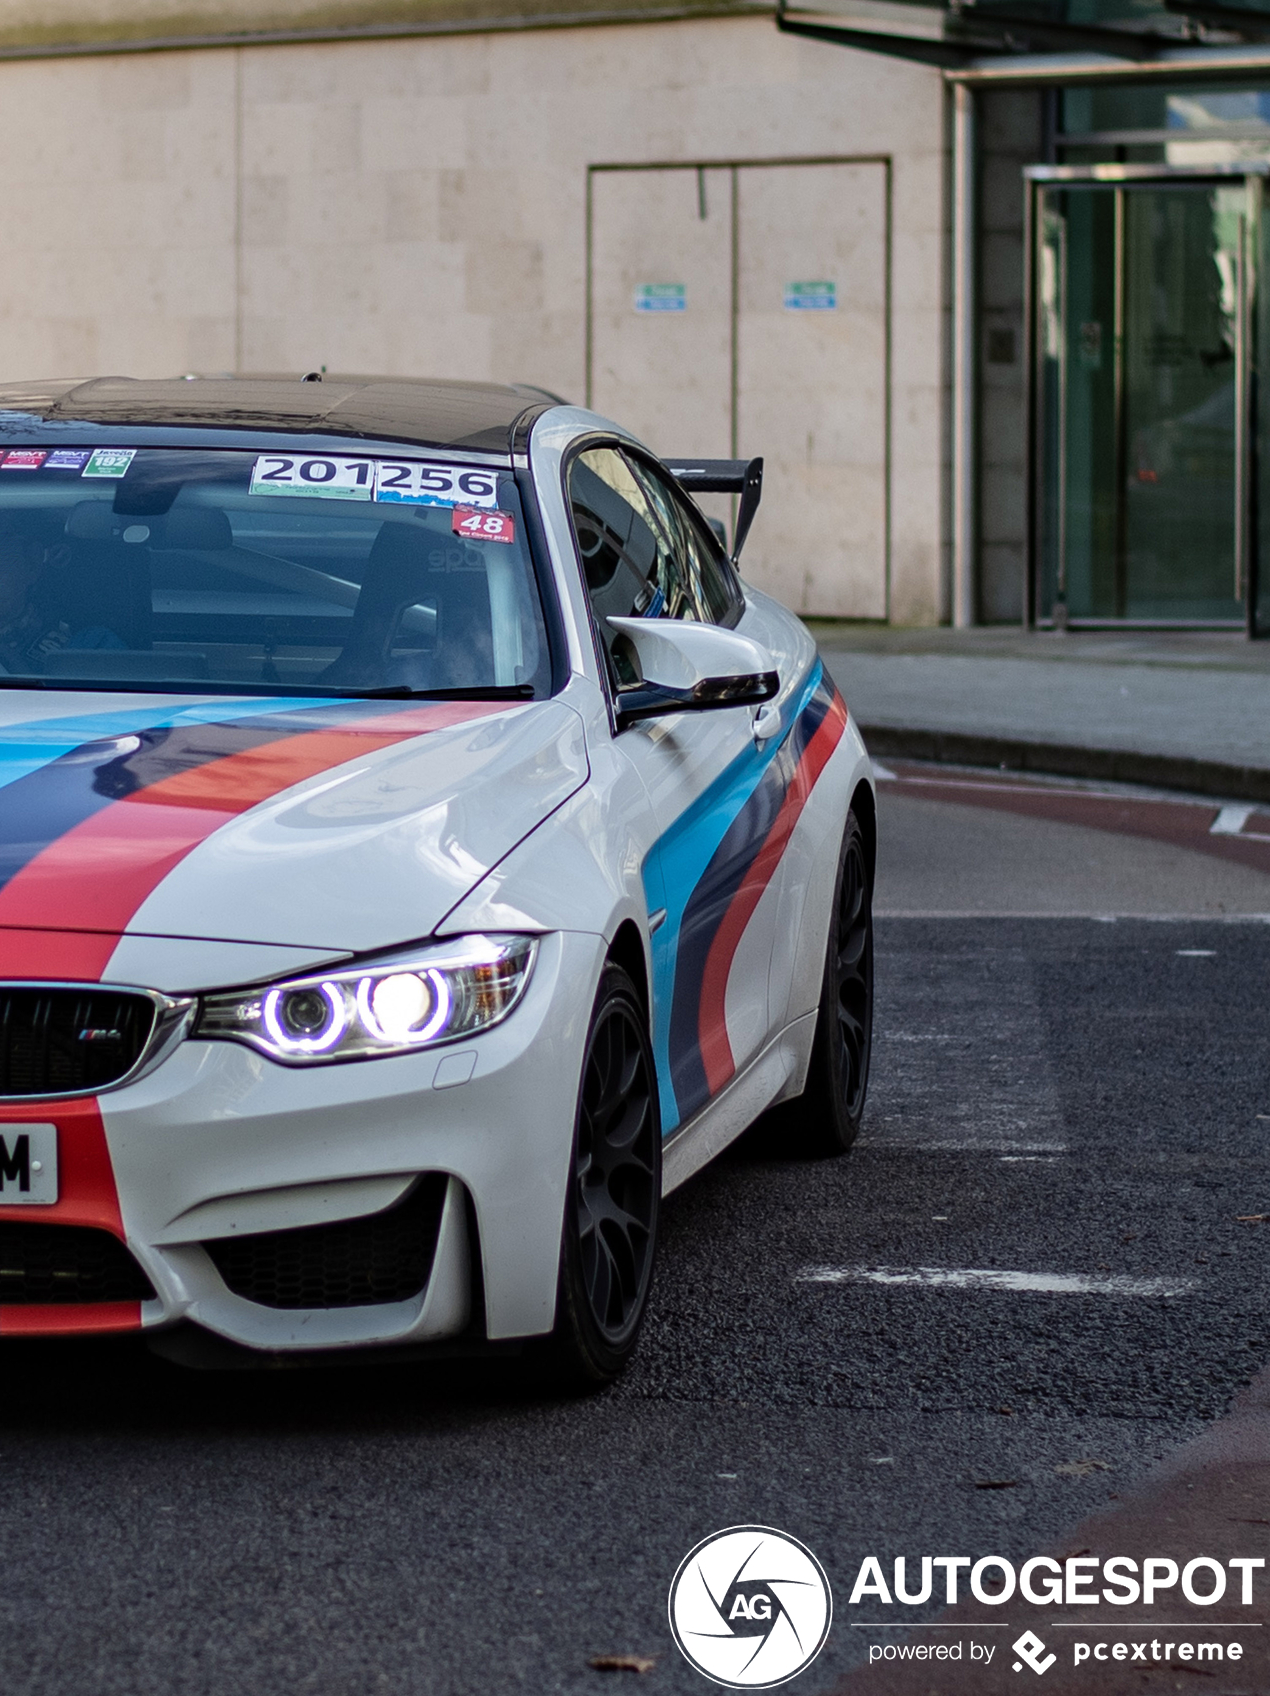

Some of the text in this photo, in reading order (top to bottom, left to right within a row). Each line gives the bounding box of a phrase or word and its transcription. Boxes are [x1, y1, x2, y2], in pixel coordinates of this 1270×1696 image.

[95, 457, 127, 467] 192
[261, 458, 369, 485] 201
[381, 465, 494, 497] 256
[460, 515, 504, 533] 48
